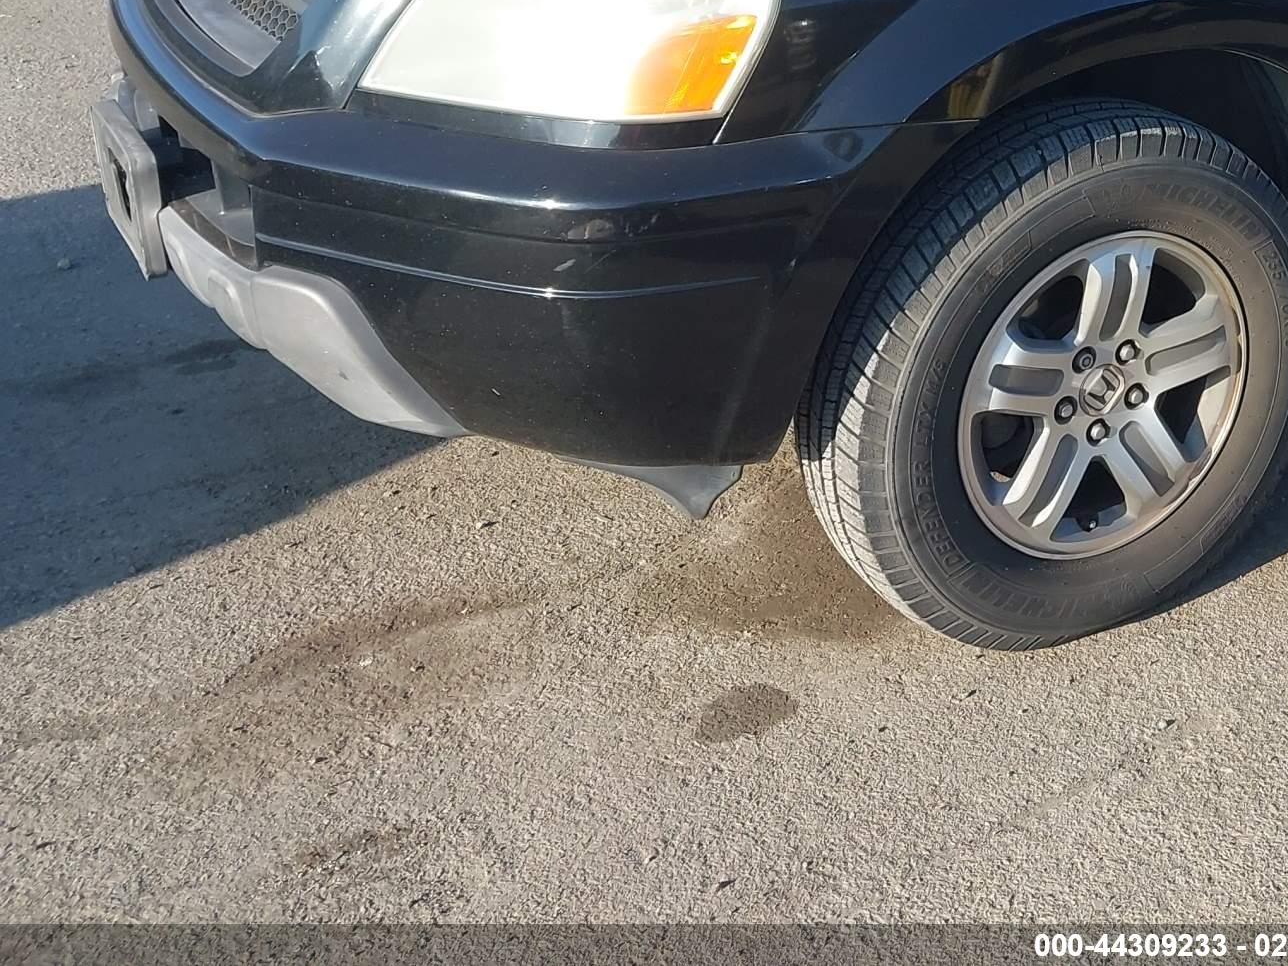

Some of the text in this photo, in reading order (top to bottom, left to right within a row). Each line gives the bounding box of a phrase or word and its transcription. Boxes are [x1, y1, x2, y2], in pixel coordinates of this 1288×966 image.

[1141, 182, 1265, 242] MICHELIN
[914, 401, 932, 448] LTX
[914, 457, 960, 566] DEFENDER
